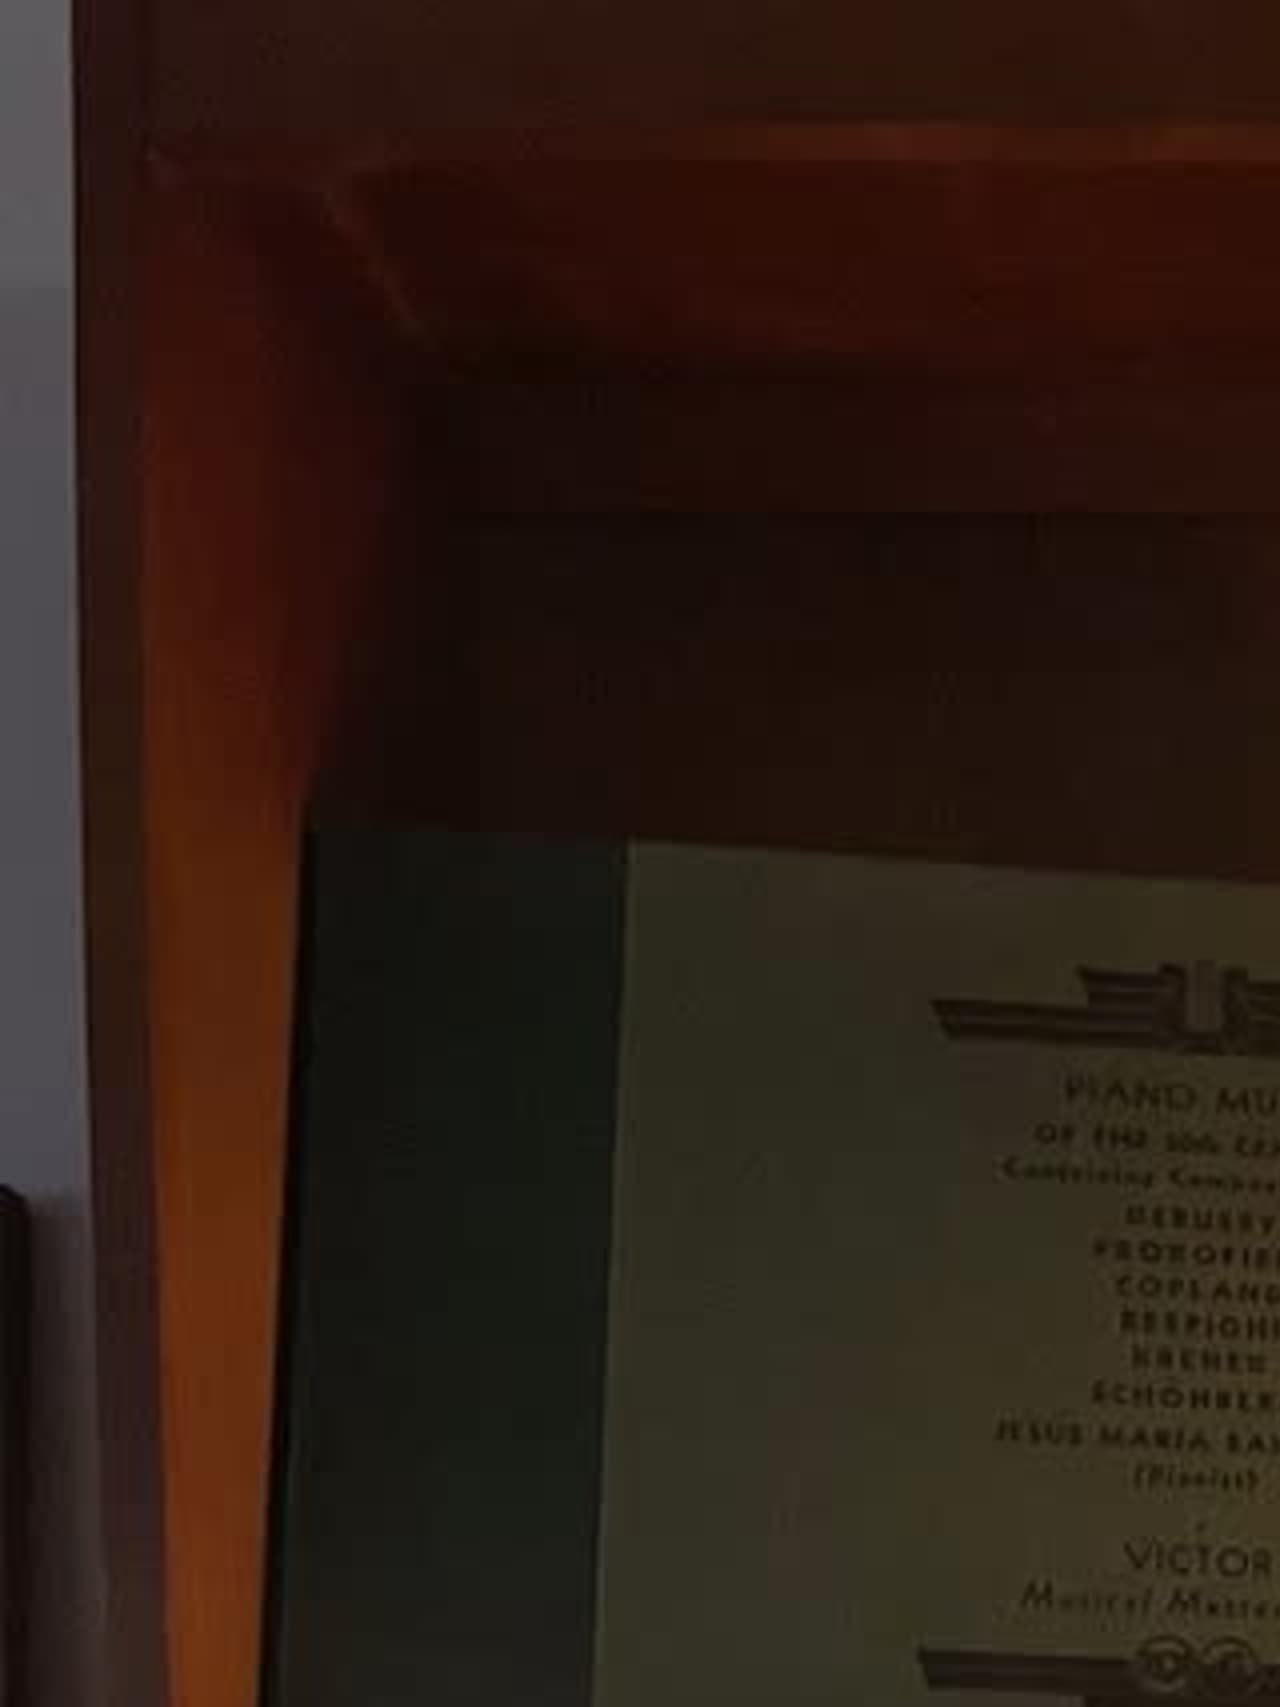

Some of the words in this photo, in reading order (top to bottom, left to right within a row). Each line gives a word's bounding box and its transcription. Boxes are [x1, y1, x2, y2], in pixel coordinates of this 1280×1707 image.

[1063, 1073, 1198, 1112] PIANO
[1034, 1121, 1075, 1145] OF
[1094, 1122, 1149, 1150] THE
[1125, 1204, 1276, 1236] DEBUSSY
[1121, 1309, 1280, 1343] RESPIGHI
[1123, 1537, 1273, 1580] VICTOR
